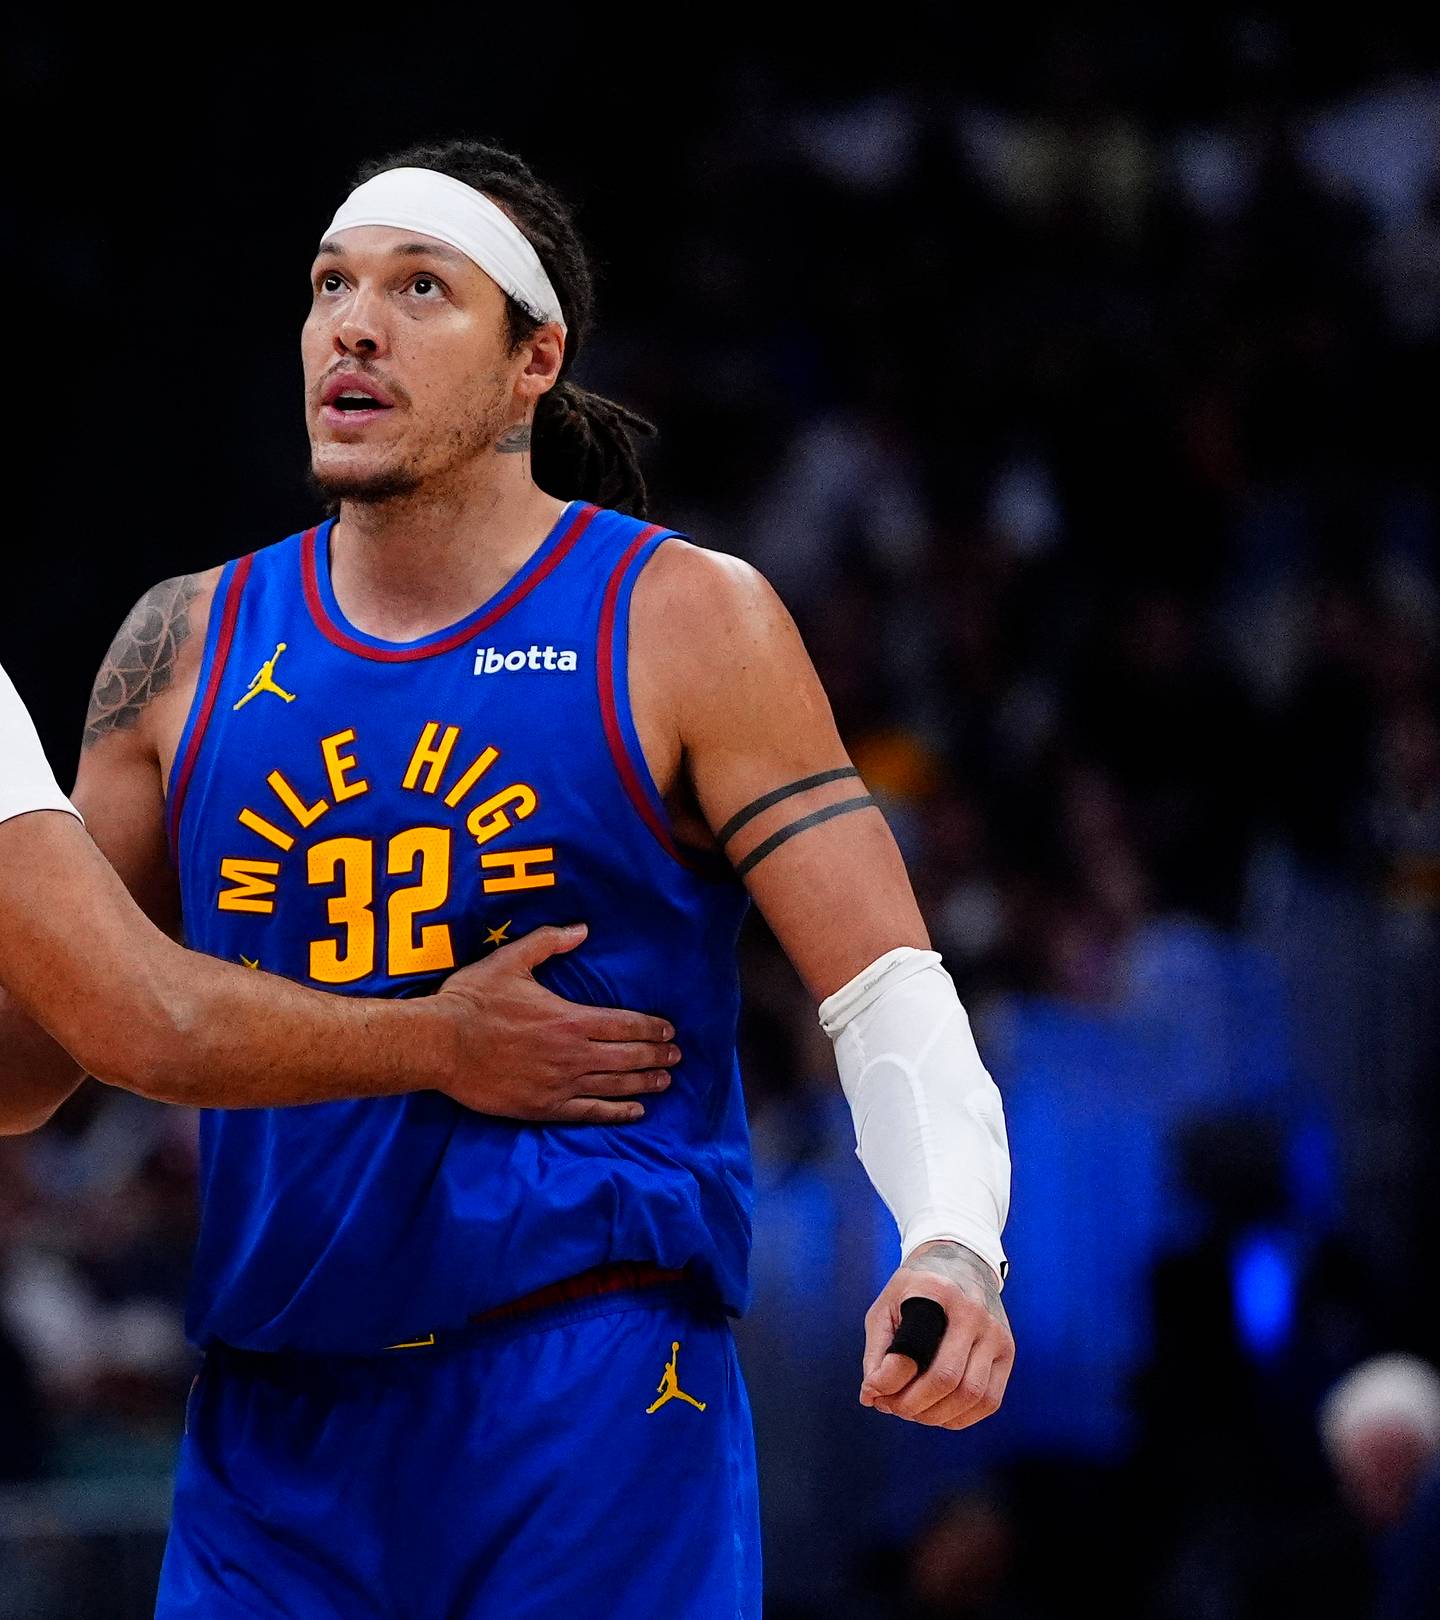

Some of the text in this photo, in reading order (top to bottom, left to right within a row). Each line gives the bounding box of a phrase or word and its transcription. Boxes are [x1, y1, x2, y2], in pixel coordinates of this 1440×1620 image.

[473, 645, 577, 676] ibotta
[216, 721, 556, 914] MILE HIGH
[306, 826, 456, 984] 32
